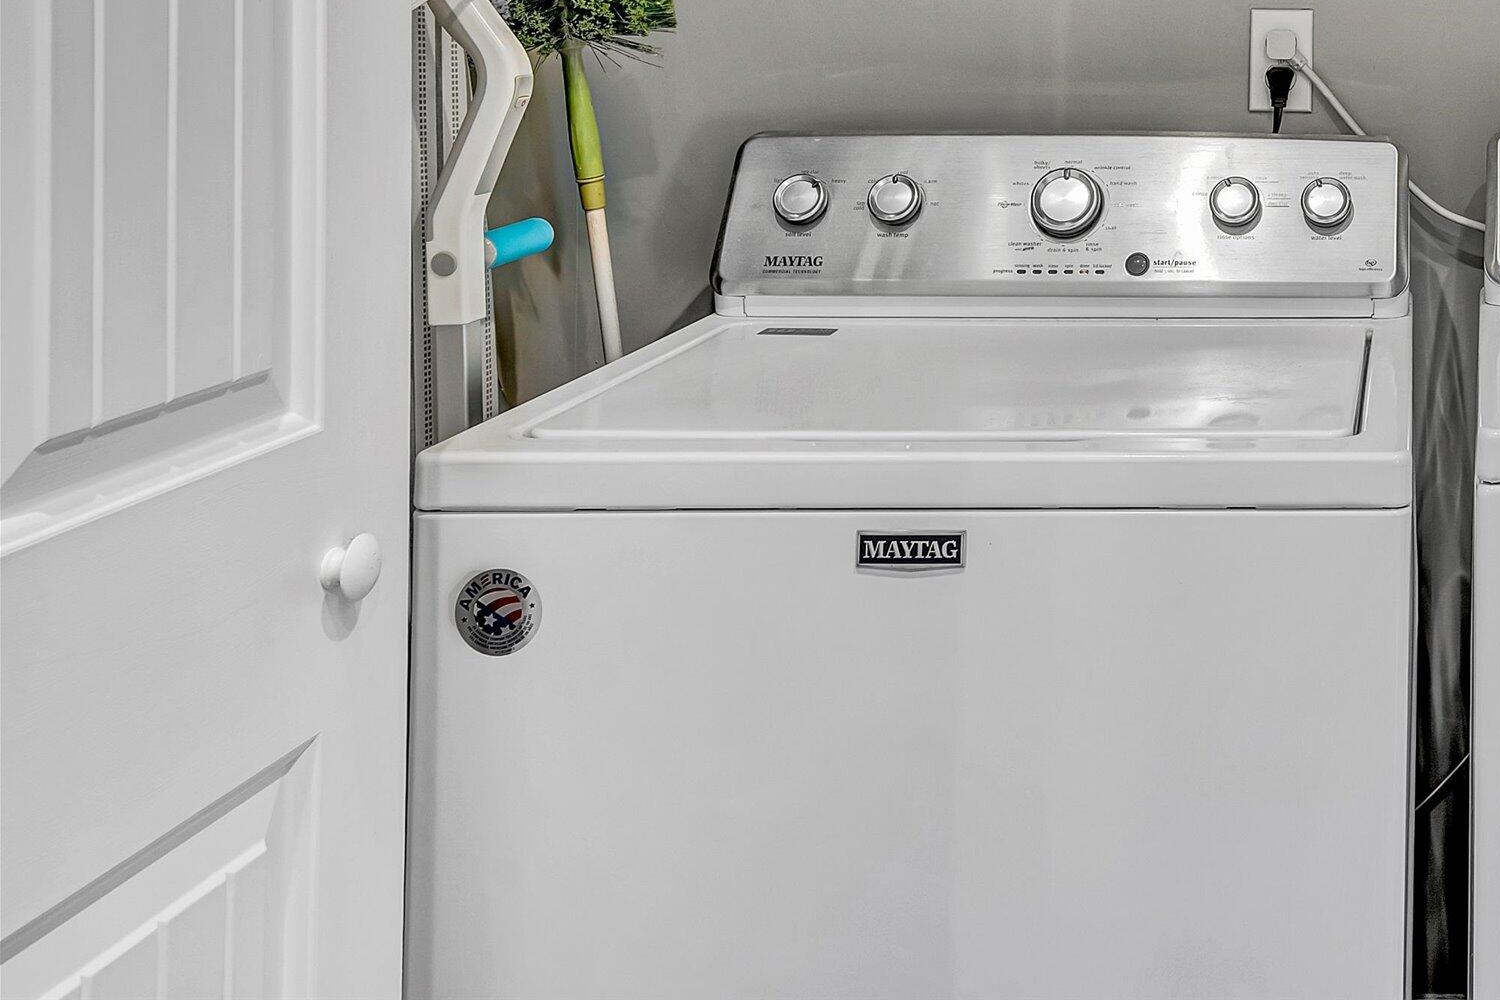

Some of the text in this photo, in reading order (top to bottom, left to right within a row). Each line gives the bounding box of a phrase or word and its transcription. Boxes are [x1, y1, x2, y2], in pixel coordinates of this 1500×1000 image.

[764, 256, 823, 267] MAYTAG
[1153, 259, 1196, 267] start/pause
[863, 541, 958, 559] MAYTAG
[460, 573, 531, 611] AMERICA
